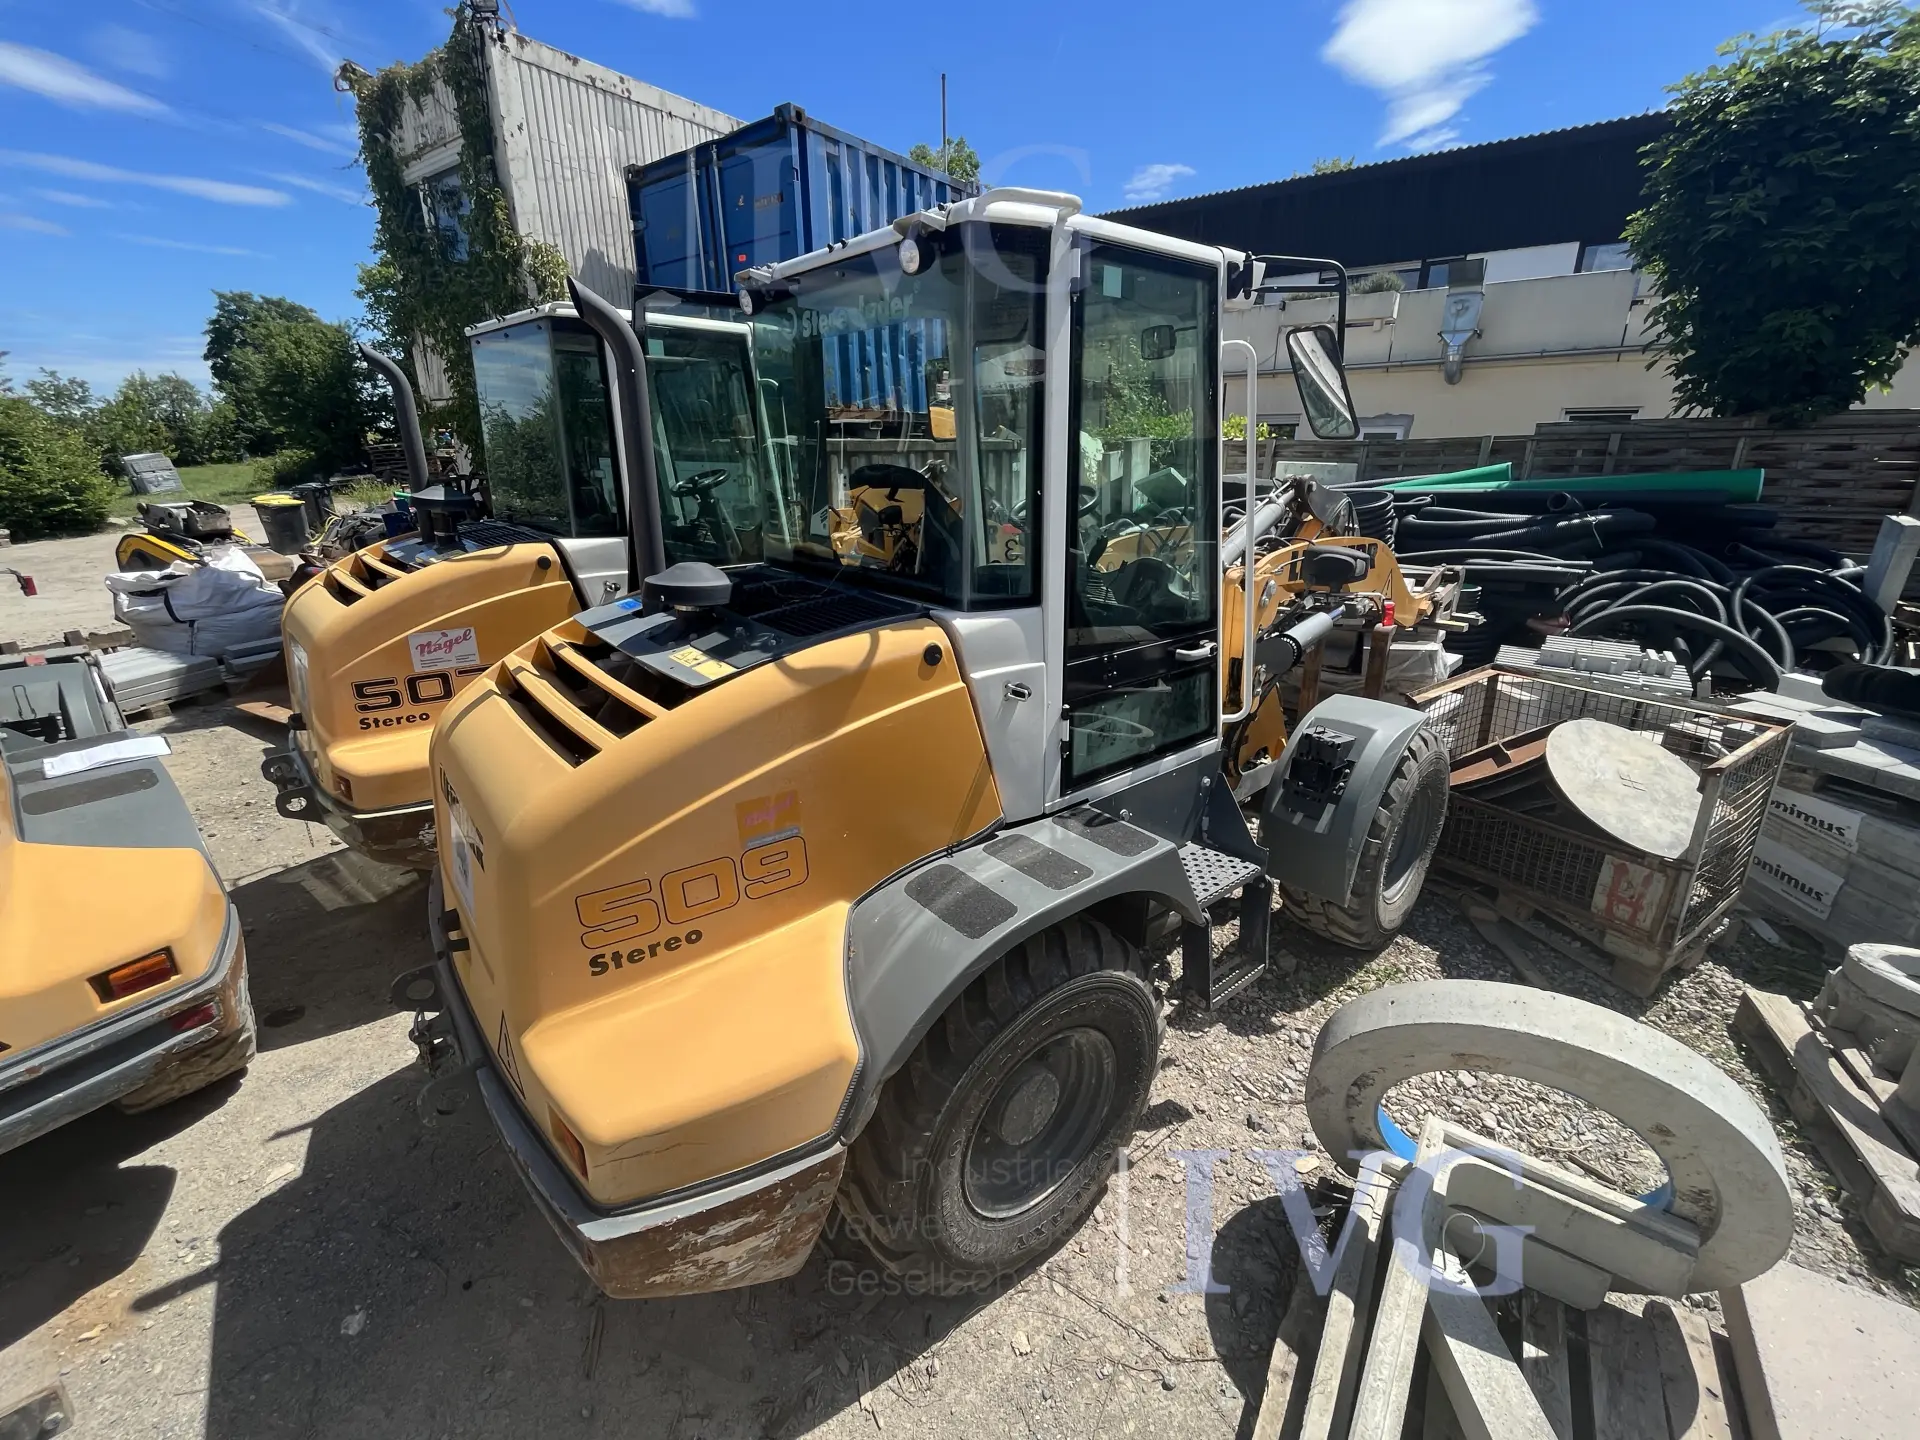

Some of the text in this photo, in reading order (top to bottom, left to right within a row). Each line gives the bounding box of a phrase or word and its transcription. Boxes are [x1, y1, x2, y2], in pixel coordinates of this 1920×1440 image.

[351, 664, 492, 714] 50
[359, 712, 431, 731] Stereo
[575, 836, 809, 951] 509
[588, 928, 703, 977] Stereo
